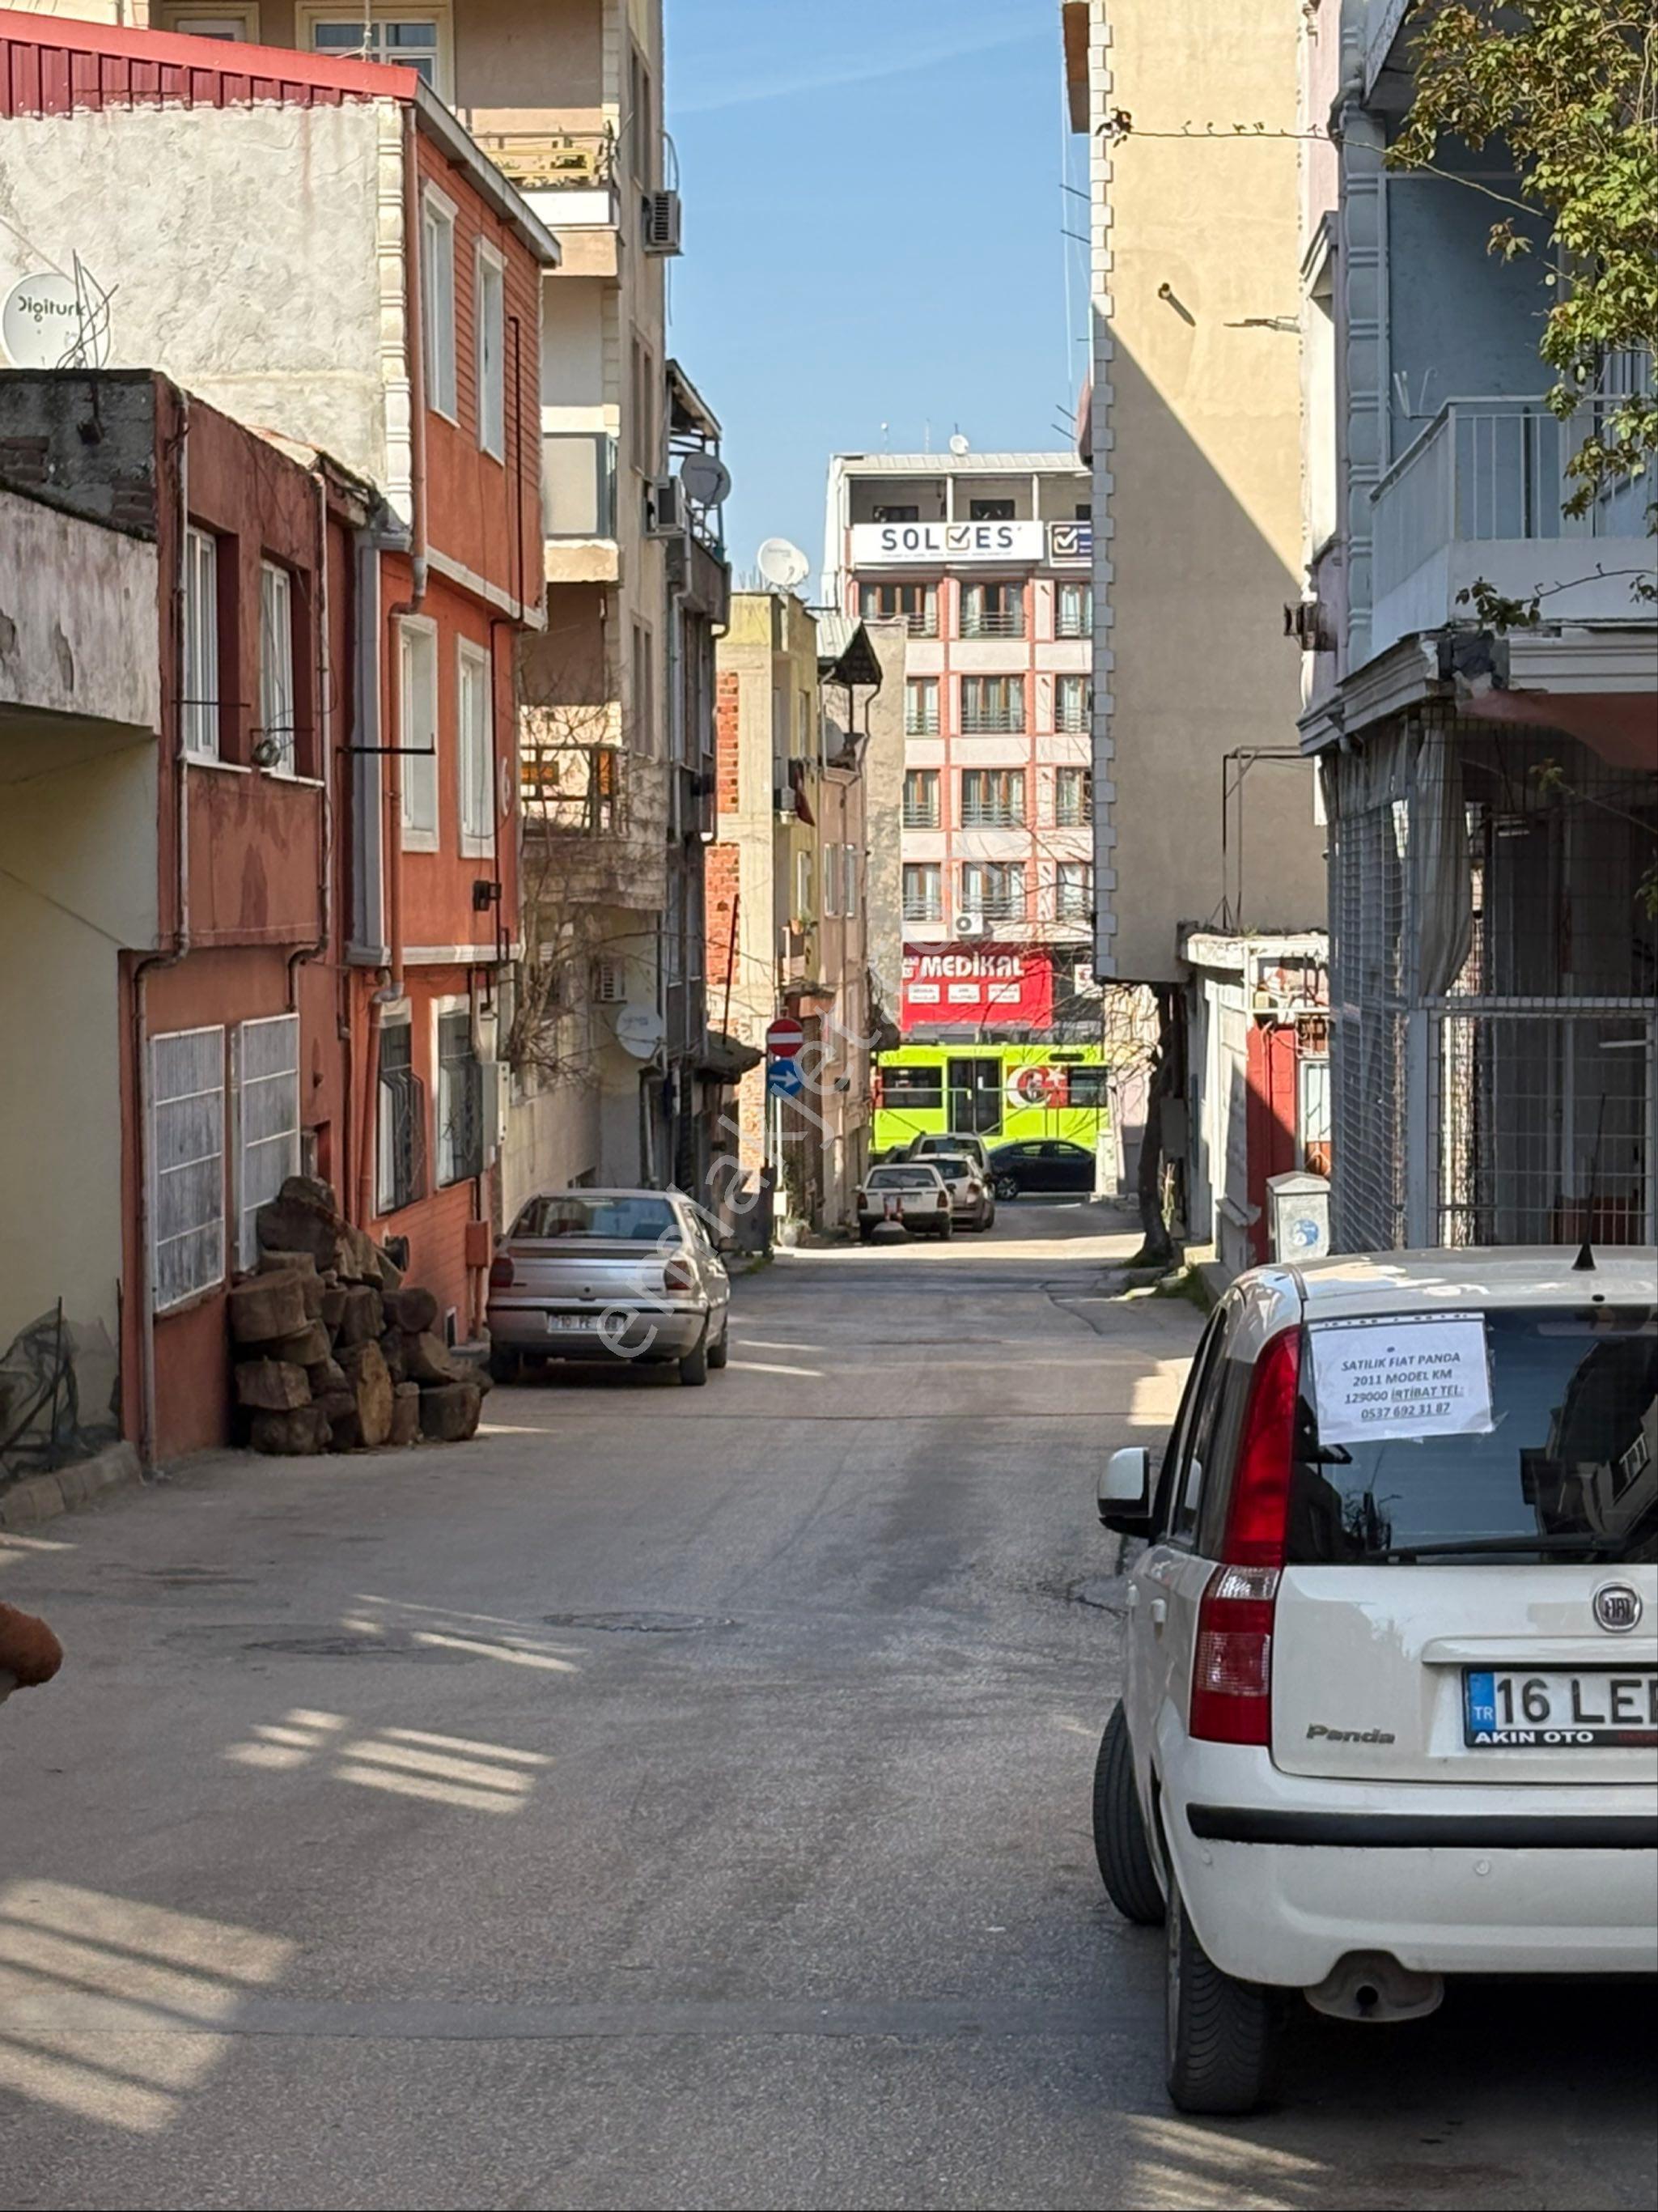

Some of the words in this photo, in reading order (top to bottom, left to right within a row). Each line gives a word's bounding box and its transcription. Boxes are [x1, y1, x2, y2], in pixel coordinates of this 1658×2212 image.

[919, 951, 1025, 979] MEDİKAL
[1341, 1359, 1386, 1372] SATILIK
[1389, 1356, 1415, 1368] FIAT
[1418, 1352, 1461, 1365] PANDA
[1353, 1374, 1382, 1387] 2011
[1385, 1371, 1430, 1385] MODEL
[1432, 1369, 1452, 1380] KM
[1361, 1407, 1391, 1421] 0537
[1418, 1403, 1432, 1416] 31
[1496, 1678, 1550, 1725] 16
[1473, 1705, 1493, 1720] TR
[1305, 1722, 1395, 1745] Panda
[1474, 1730, 1536, 1743] AKIN
[1543, 1730, 1594, 1743] OTO
